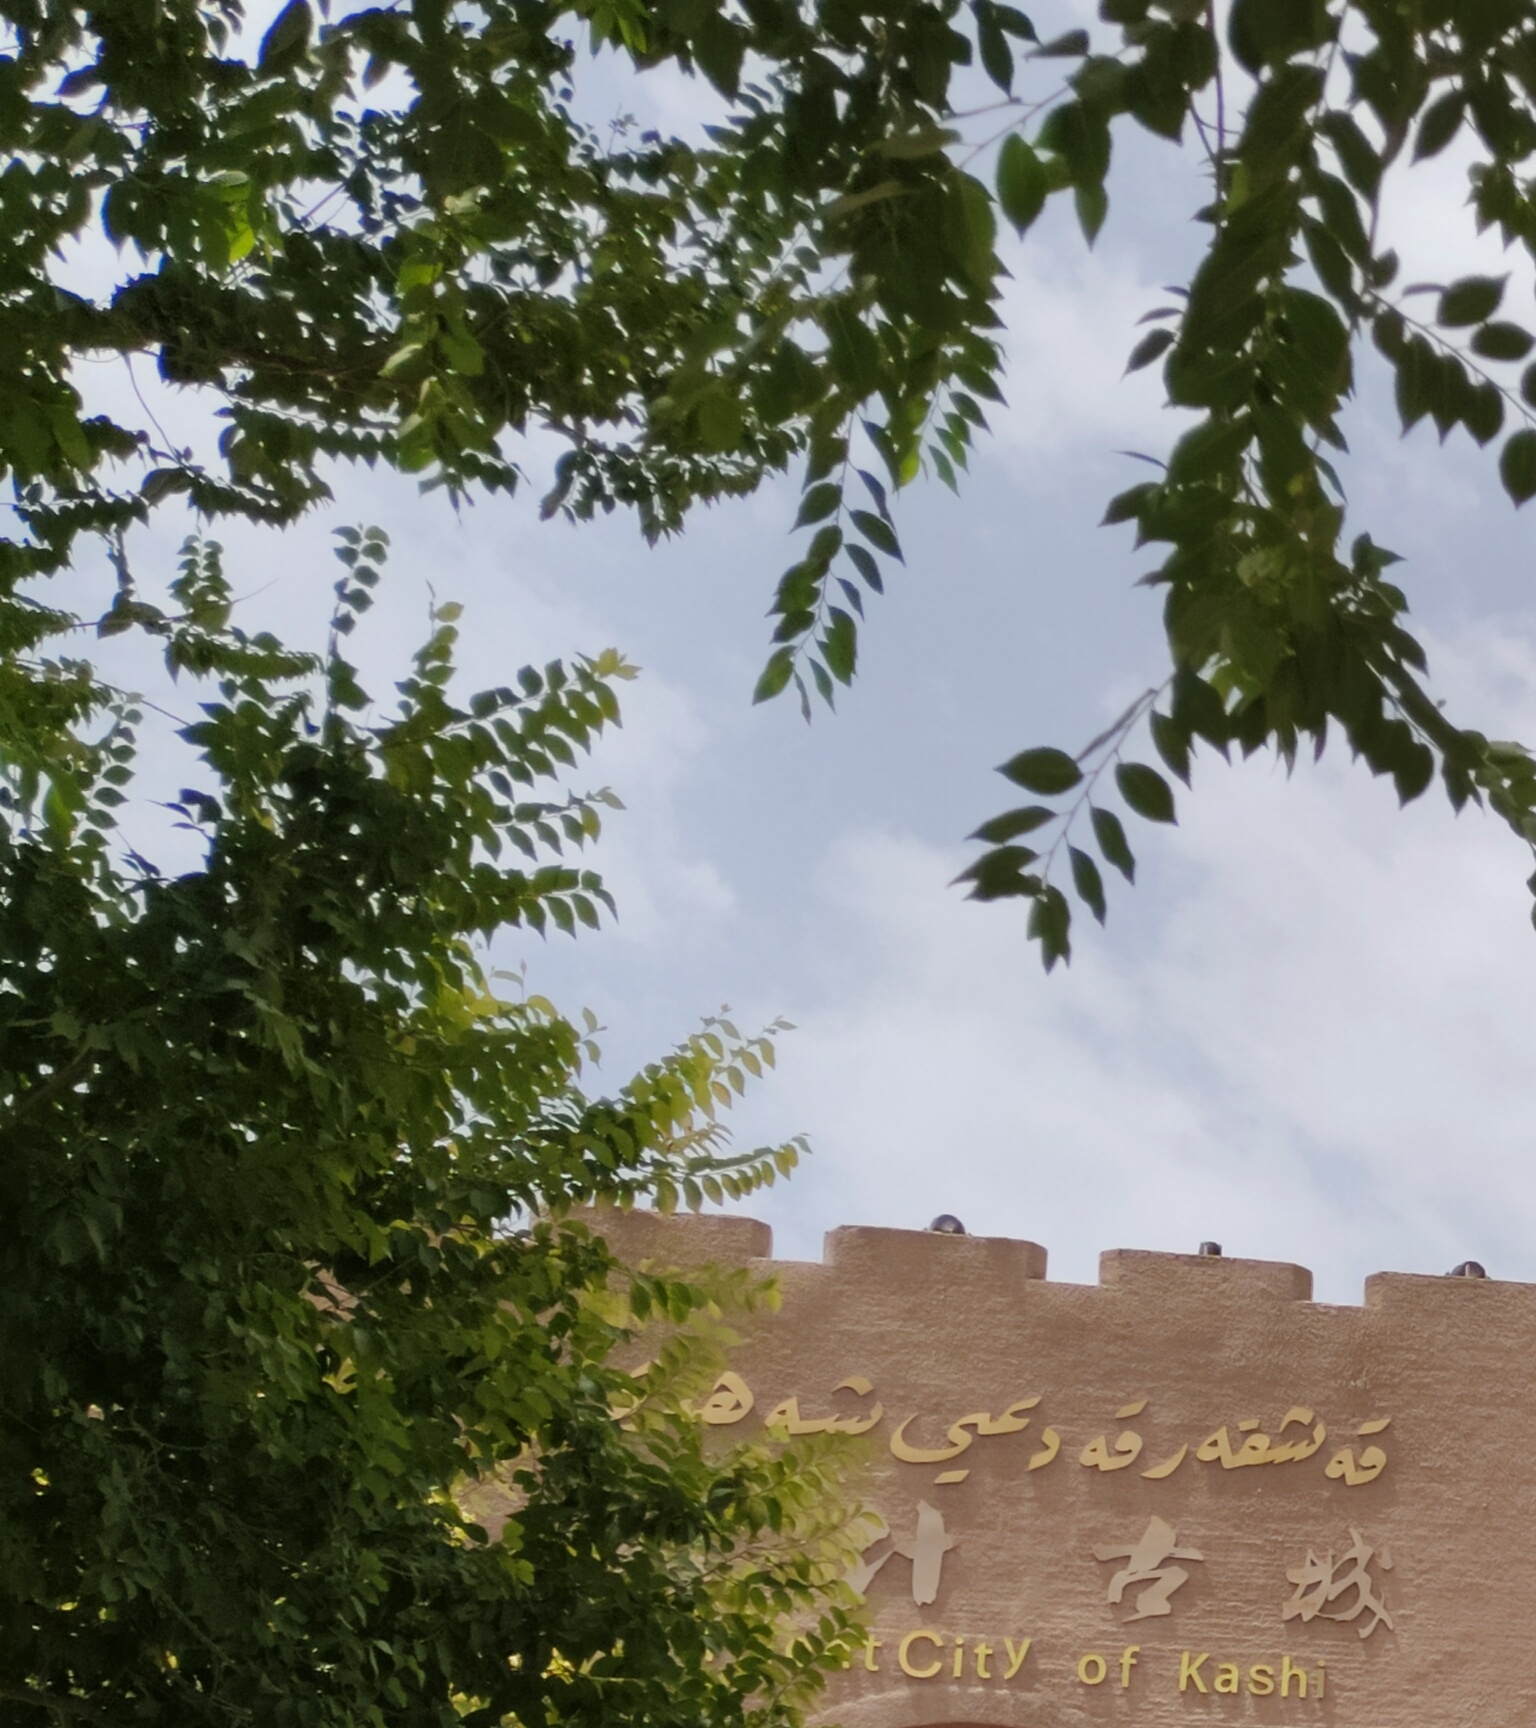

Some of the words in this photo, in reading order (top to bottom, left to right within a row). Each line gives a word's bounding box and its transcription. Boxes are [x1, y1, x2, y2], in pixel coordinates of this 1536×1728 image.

[898, 1630, 1031, 1679] City
[1077, 1645, 1140, 1688] of
[1179, 1650, 1325, 1698] Kashi
